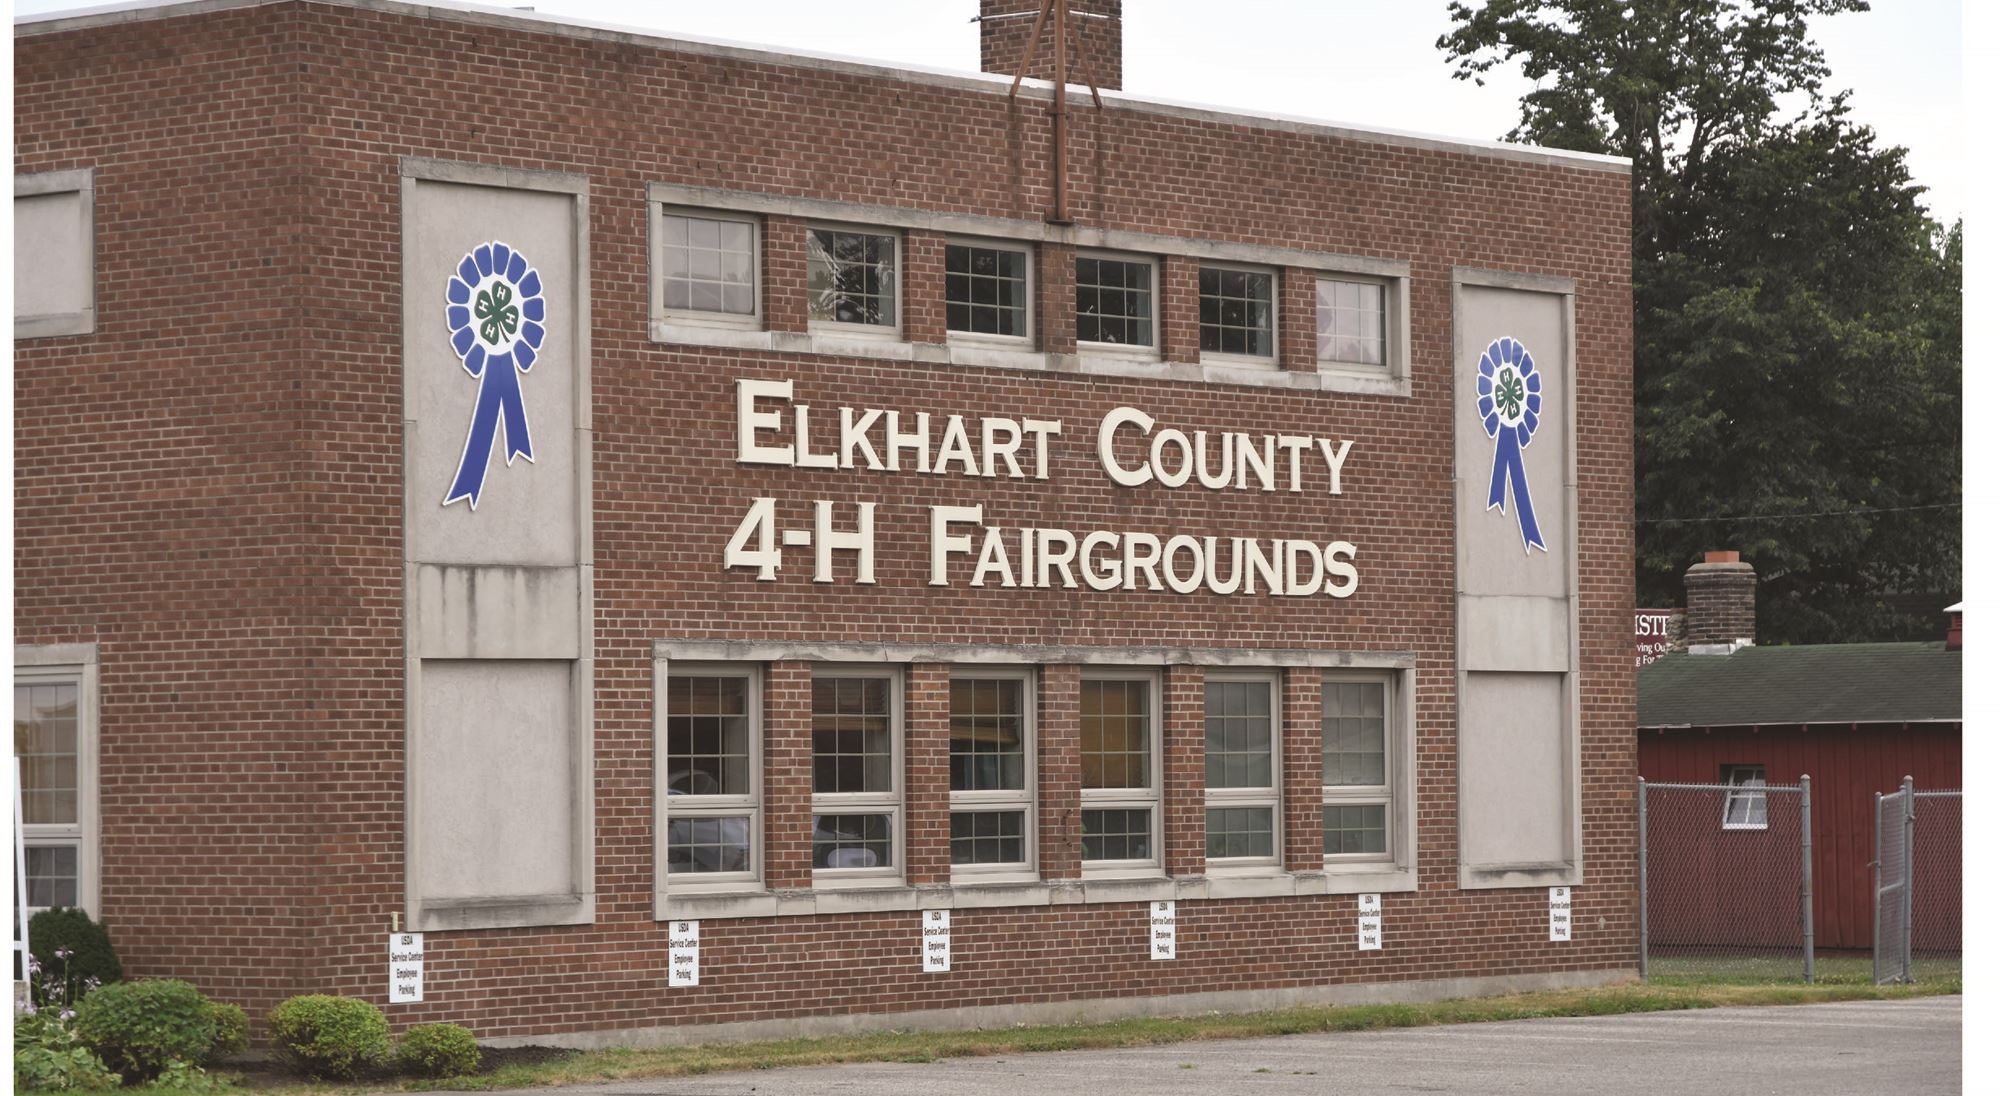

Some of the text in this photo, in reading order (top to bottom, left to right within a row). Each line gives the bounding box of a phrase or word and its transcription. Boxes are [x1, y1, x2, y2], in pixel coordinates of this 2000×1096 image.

[735, 378, 1355, 495] ELKHART COUNTY
[723, 497, 1360, 598] 4-H FAIRGROUNDS
[1158, 902, 1169, 911] USDA
[931, 911, 942, 921] USDA
[1151, 916, 1175, 925] Service Center
[678, 922, 690, 933] USDA
[924, 926, 949, 937] Service Center
[401, 935, 414, 946] USDA
[1155, 930, 1171, 941] Employee
[669, 938, 698, 949] Service Center
[928, 941, 946, 952] Employee
[1156, 944, 1170, 955] Parking
[391, 951, 424, 963] Service Center
[674, 954, 694, 966] Employee
[930, 955, 945, 967] Parking
[396, 968, 418, 980] Employee
[676, 969, 692, 981] Parking
[398, 984, 416, 997] Parking
